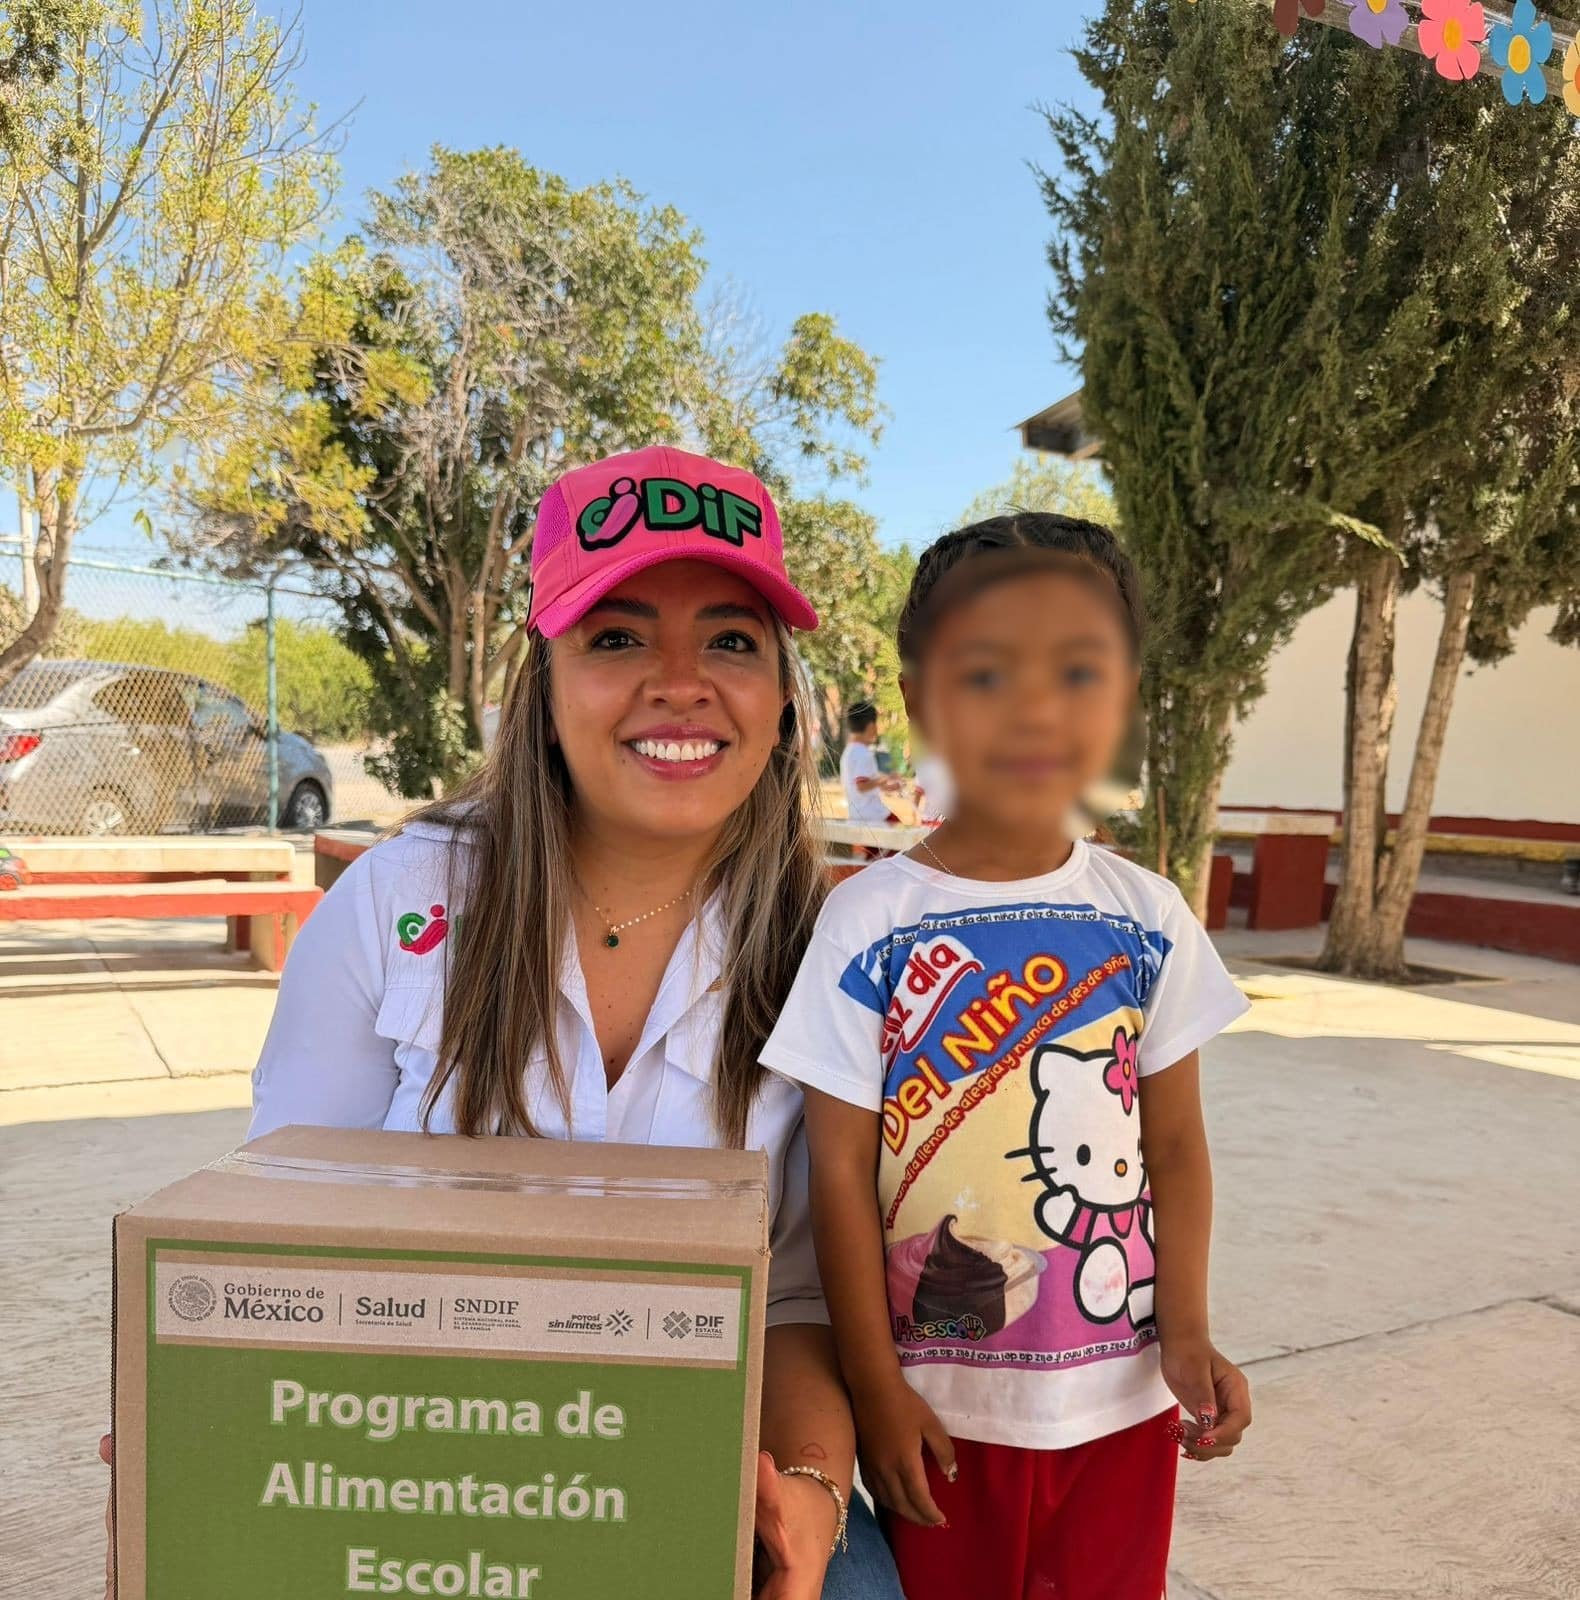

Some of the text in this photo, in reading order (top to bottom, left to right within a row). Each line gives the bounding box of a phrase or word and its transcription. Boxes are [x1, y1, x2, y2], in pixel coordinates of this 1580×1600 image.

[881, 943, 960, 1055] eliz día
[881, 953, 1068, 1156] Del Niño
[915, 1125, 950, 1165] lleno
[942, 1104, 965, 1131] de
[960, 1063, 1005, 1111] alegría
[1001, 1052, 1020, 1071] y
[1012, 1015, 1052, 1058] nunca
[1086, 968, 1104, 988] de
[224, 1283, 324, 1299] Gobierno de
[224, 1297, 323, 1322] México
[356, 1297, 425, 1318] Salud
[454, 1298, 519, 1315] SNDIF
[696, 1315, 724, 1327] DIF
[270, 1378, 626, 1439] Programa de
[260, 1461, 627, 1522] Alimentación
[346, 1547, 541, 1600] Escolar
